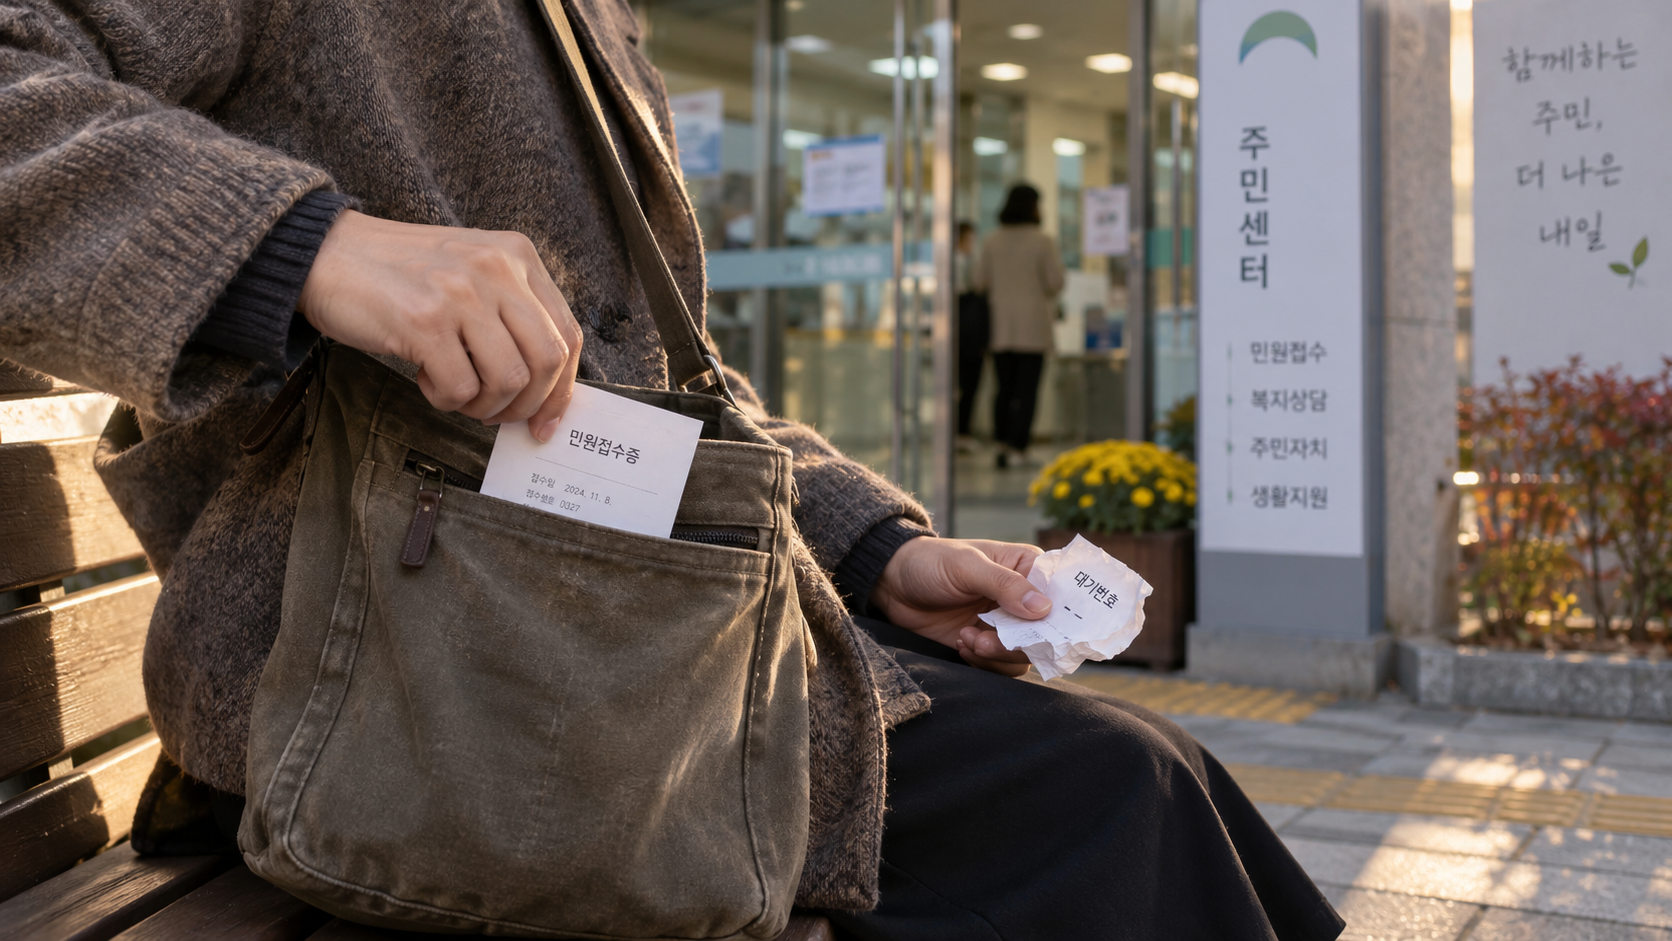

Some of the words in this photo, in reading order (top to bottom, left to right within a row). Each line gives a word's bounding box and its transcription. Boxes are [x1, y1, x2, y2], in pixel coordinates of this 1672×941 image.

[1502, 36, 1638, 83] 함께하는
[1532, 96, 1602, 136] 주민,
[1516, 159, 1544, 190] 더
[1562, 152, 1623, 188] 나은
[1239, 126, 1269, 289] 주민센터
[1539, 209, 1606, 252] 내일
[1250, 341, 1328, 364] 민원접수
[1251, 389, 1328, 412] 복지상담
[569, 429, 640, 465] 민원접수증
[1251, 437, 1328, 460] 주민자치
[559, 500, 581, 512] 0327
[564, 484, 586, 498] 2024.
[1251, 485, 1328, 510] 생활지원
[1074, 571, 1119, 609] 대기번호
